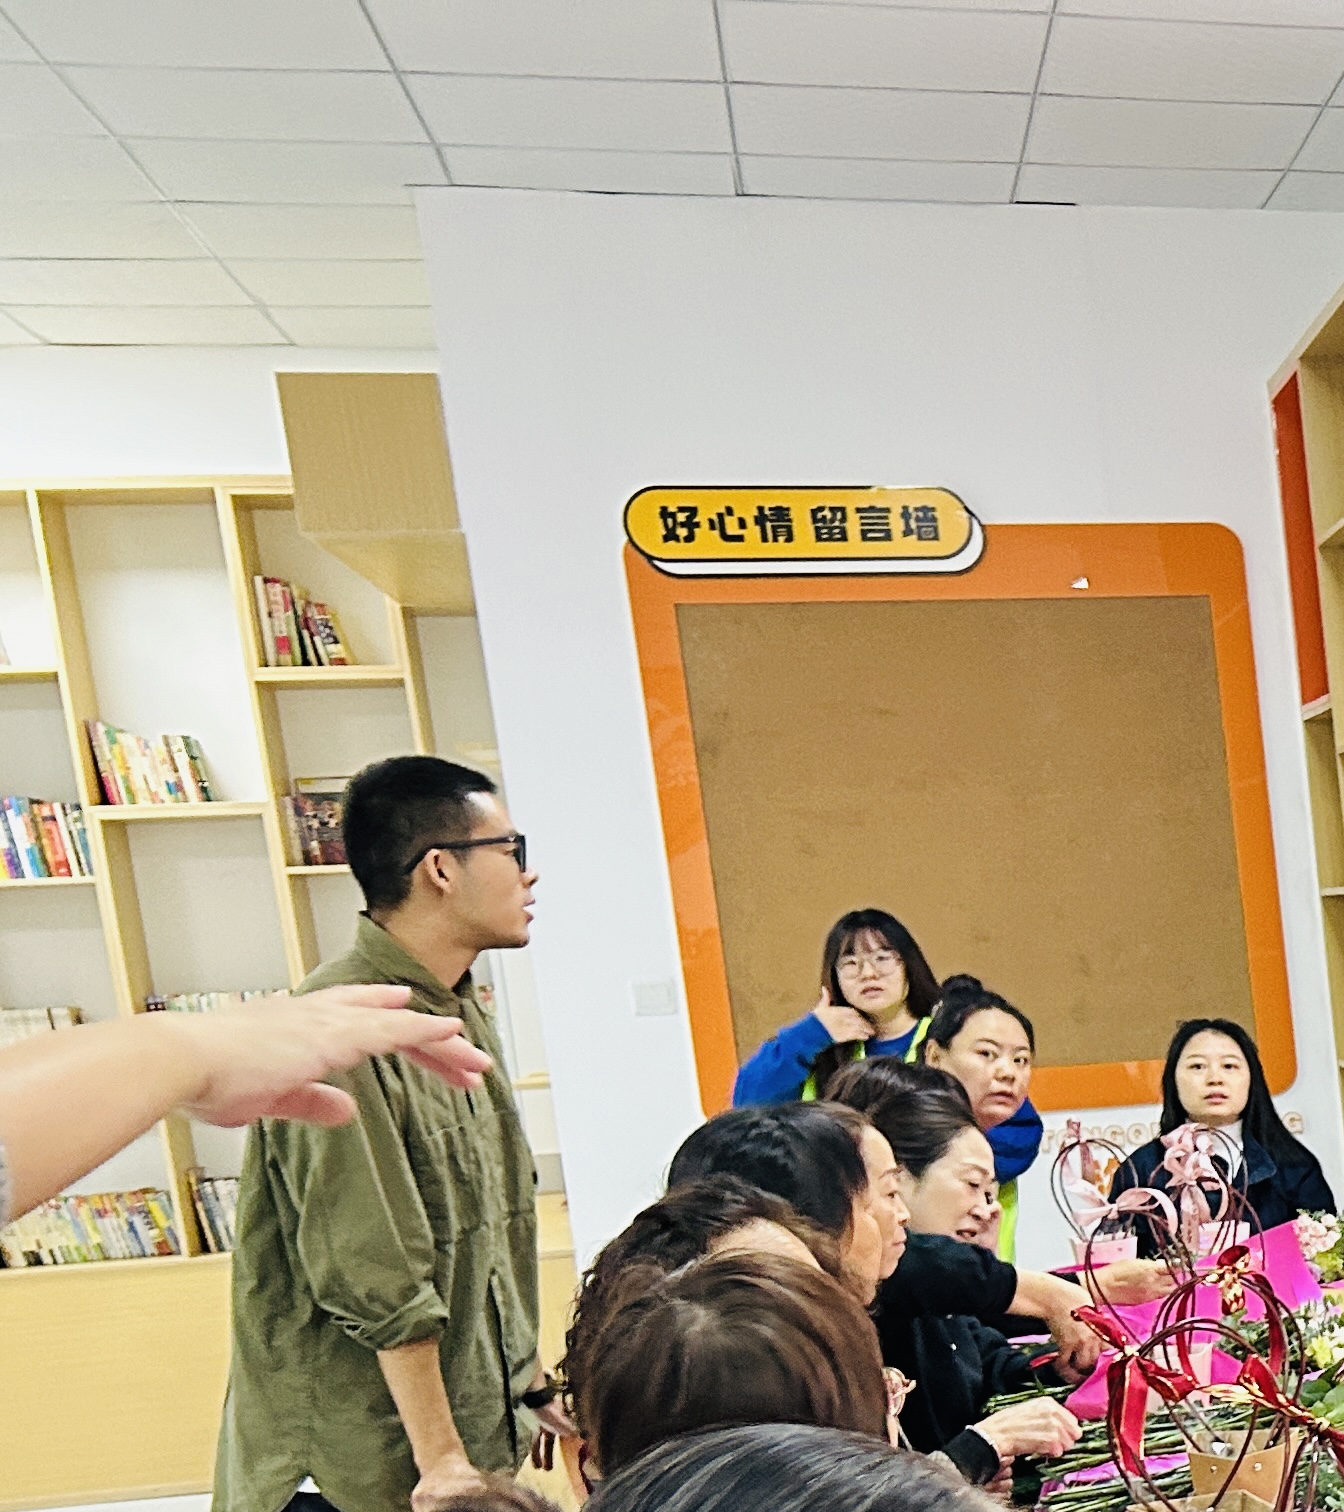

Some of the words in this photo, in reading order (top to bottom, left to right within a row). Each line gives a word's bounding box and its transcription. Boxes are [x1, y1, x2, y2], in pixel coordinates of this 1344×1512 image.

[659, 506, 794, 543] 好心情
[810, 506, 939, 542] 留言墙
